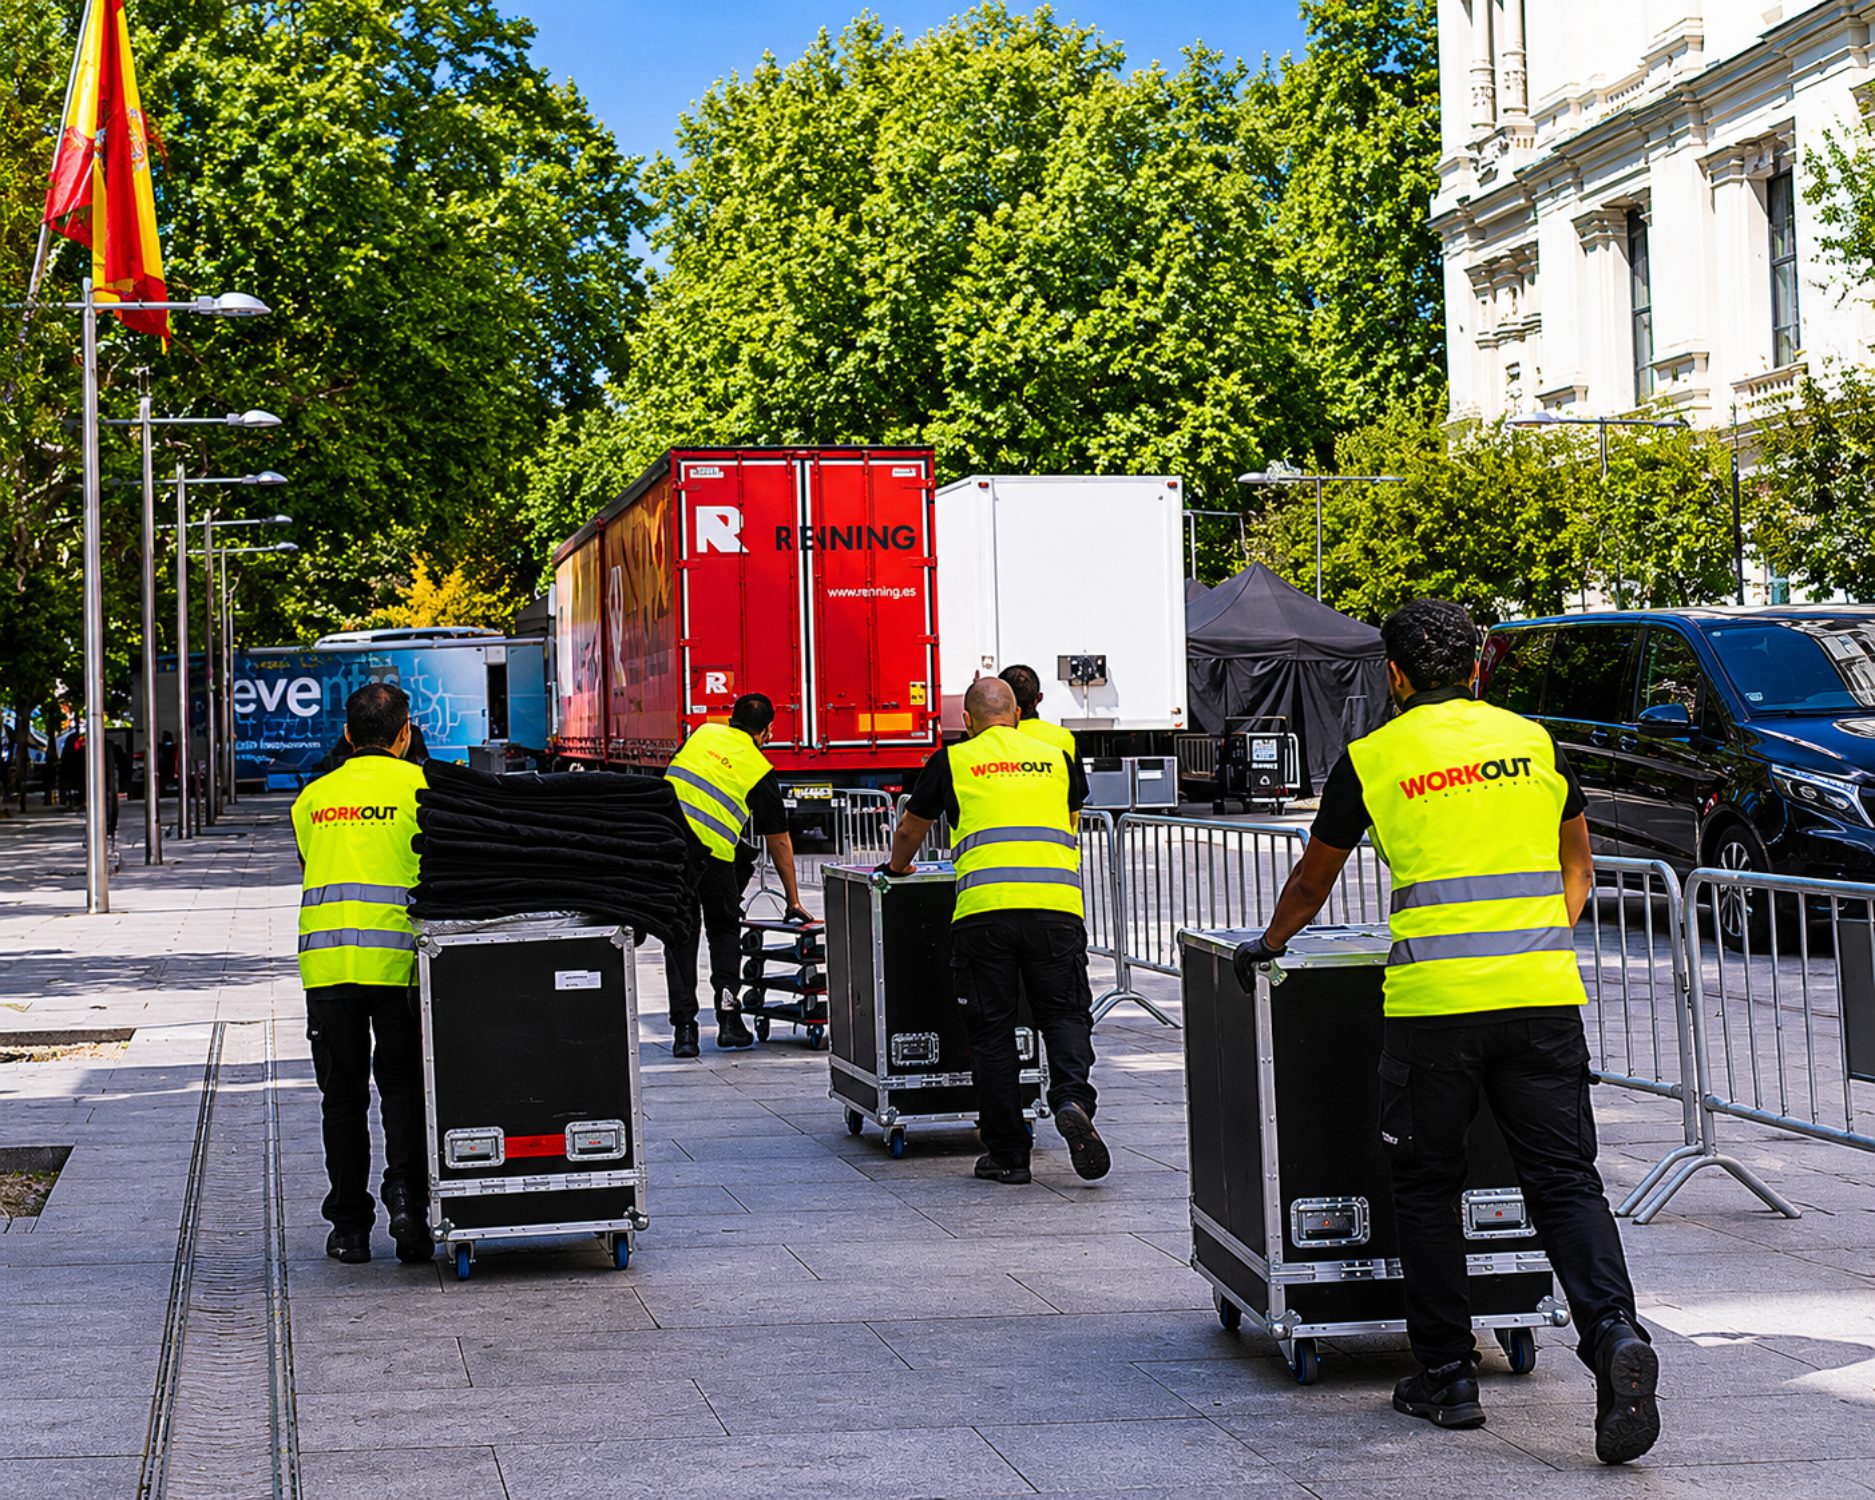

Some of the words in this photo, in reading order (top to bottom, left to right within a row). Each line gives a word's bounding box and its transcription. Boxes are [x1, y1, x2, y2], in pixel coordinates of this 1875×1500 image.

[775, 525, 916, 551] RENNING
[827, 585, 917, 600] www.renning.es
[969, 761, 1054, 778] WORKOUT
[1399, 757, 1532, 800] WORKOUT
[310, 806, 398, 825] WORKOUT
